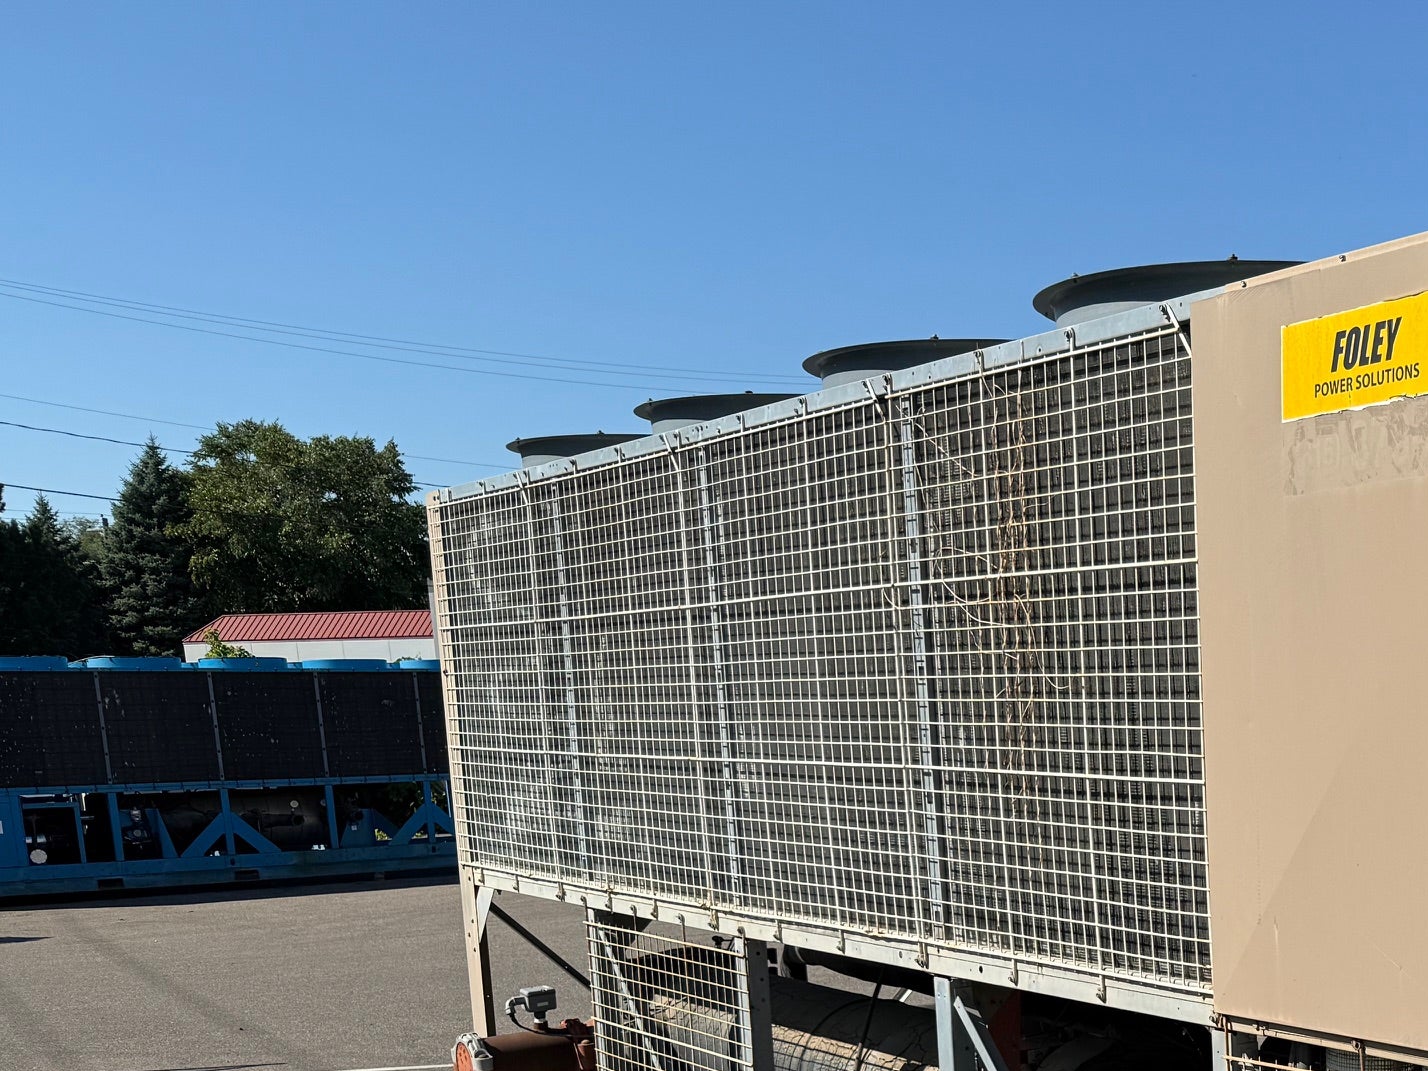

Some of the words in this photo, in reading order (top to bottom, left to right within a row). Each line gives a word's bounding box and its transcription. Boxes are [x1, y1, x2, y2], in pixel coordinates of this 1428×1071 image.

[1330, 316, 1403, 373] FOLEY
[1314, 376, 1354, 398] POWER
[1355, 362, 1420, 389] SOLUTIONS
